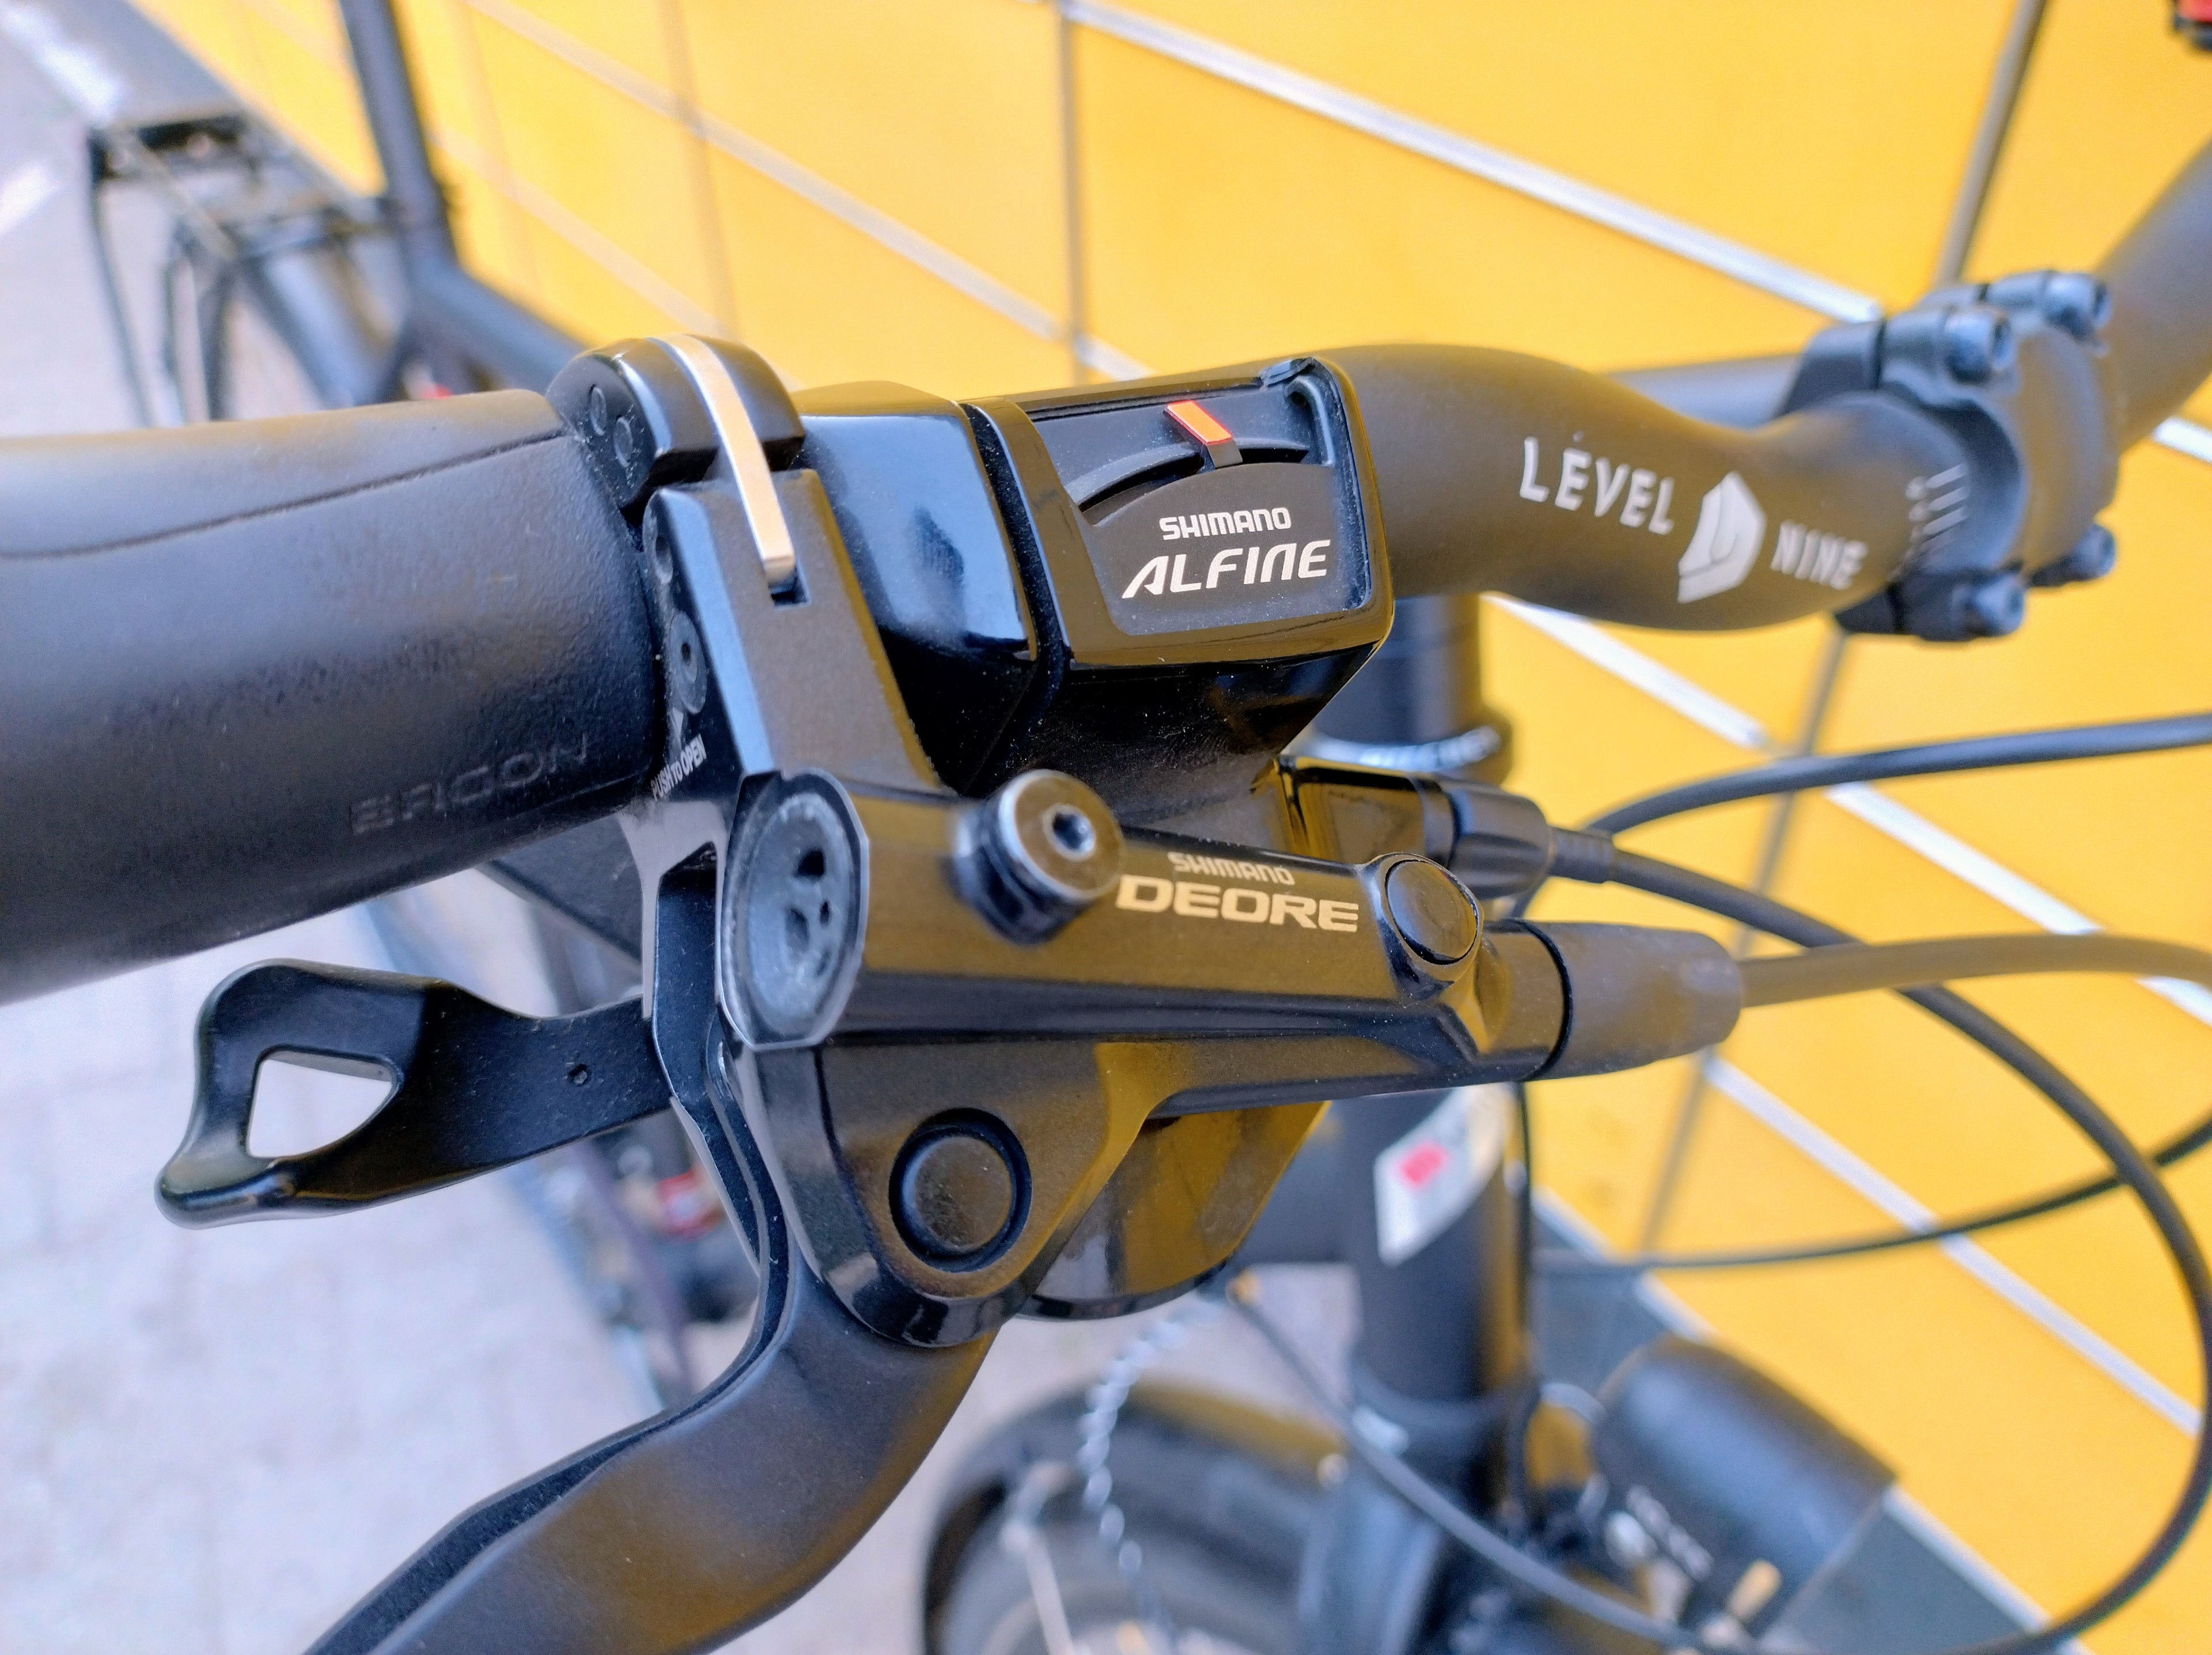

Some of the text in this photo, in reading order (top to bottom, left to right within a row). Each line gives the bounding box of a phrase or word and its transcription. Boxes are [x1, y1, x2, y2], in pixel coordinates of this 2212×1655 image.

[1158, 507, 1292, 541] SHIMANO
[1518, 437, 1869, 591] LEVEL NINE
[1121, 539, 1331, 600] ALFINE
[650, 733, 707, 801] PUSH TO OPEN
[1167, 851, 1296, 886] SHIMANO
[1115, 874, 1359, 933] DEORE
